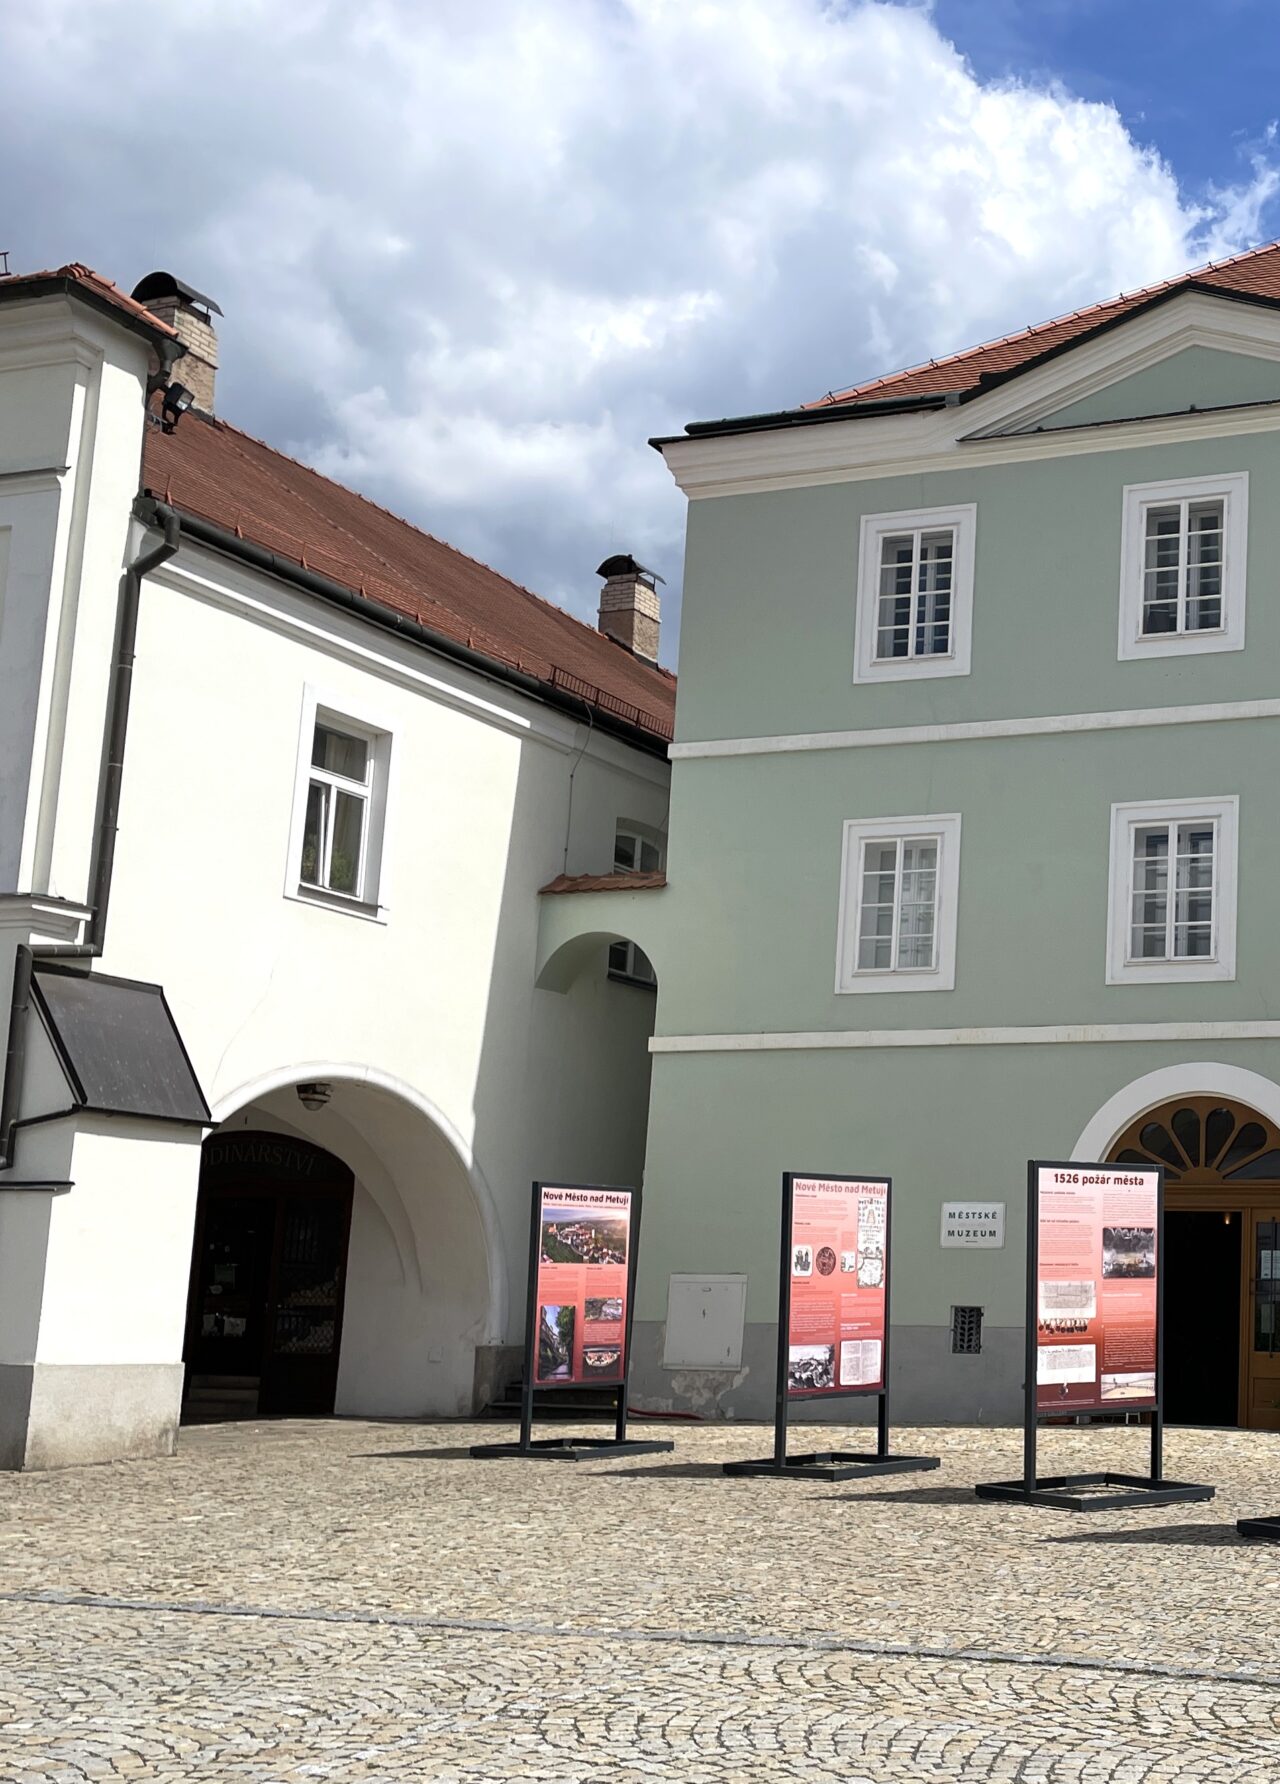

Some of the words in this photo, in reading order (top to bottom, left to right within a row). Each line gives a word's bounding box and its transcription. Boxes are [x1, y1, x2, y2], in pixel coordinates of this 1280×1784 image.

[1054, 1173, 1079, 1183] 1526
[1081, 1174, 1112, 1187] požár
[1113, 1175, 1145, 1186] města
[795, 1182, 816, 1192] Nové
[818, 1183, 842, 1193] Město
[844, 1185, 860, 1194] nad
[543, 1191, 563, 1200] Nové
[565, 1193, 588, 1202] Město
[947, 1230, 997, 1238] MUZEUM
